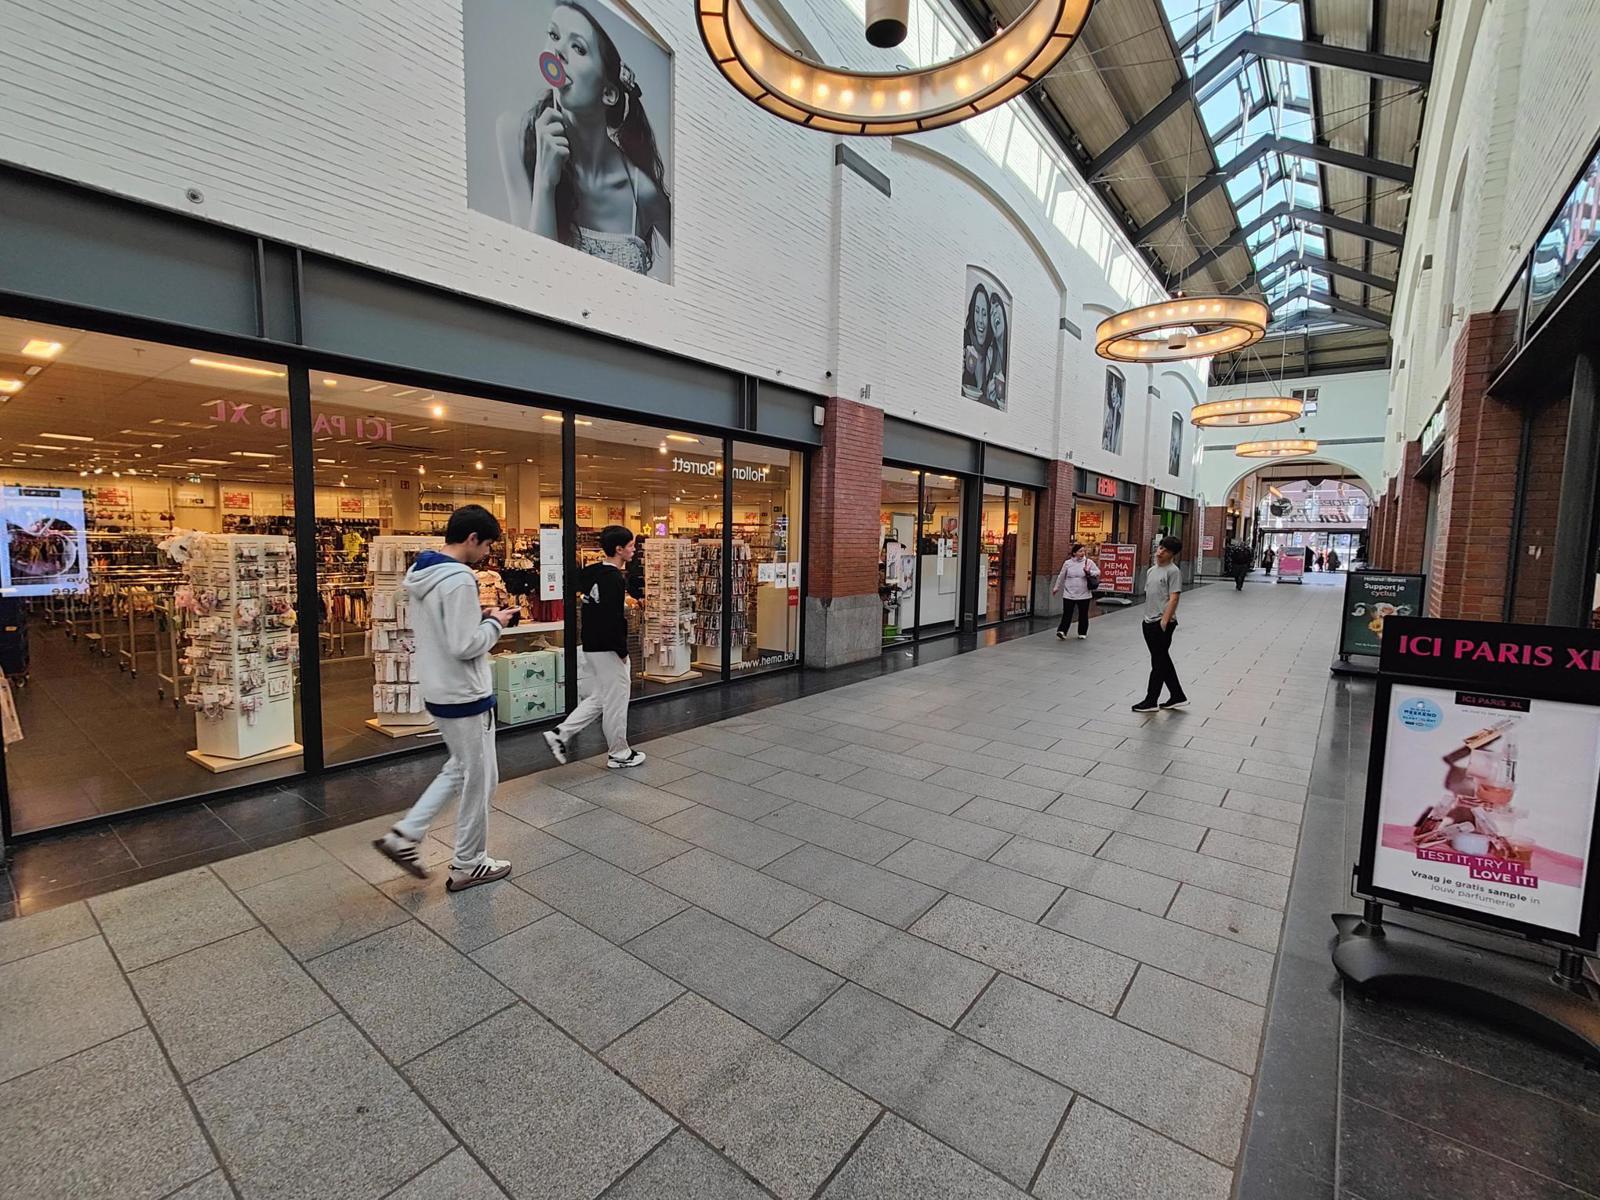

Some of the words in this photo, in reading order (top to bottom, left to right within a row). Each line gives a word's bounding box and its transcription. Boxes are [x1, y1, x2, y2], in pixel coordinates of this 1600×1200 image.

[1097, 476, 1117, 497] HEMA
[1104, 562, 1129, 570] HEMA
[1363, 583, 1397, 591] Support
[1399, 634, 1442, 657] ICI
[1454, 639, 1553, 666] PARIS
[738, 651, 794, 670] www.hema.be
[1461, 695, 1476, 703] ICI
[1419, 849, 1455, 862] TEST
[1475, 857, 1504, 871] TRY
[1507, 862, 1521, 872] IT
[1411, 870, 1440, 883] Vraag
[1442, 876, 1453, 885] je
[1455, 881, 1485, 893] gratis
[1487, 888, 1528, 902] sample
[1530, 896, 1541, 905] in
[1472, 869, 1512, 883] LOVE
[1515, 876, 1535, 887] IT!
[1430, 884, 1456, 895] jouw
[1458, 890, 1516, 909] parfumerie
